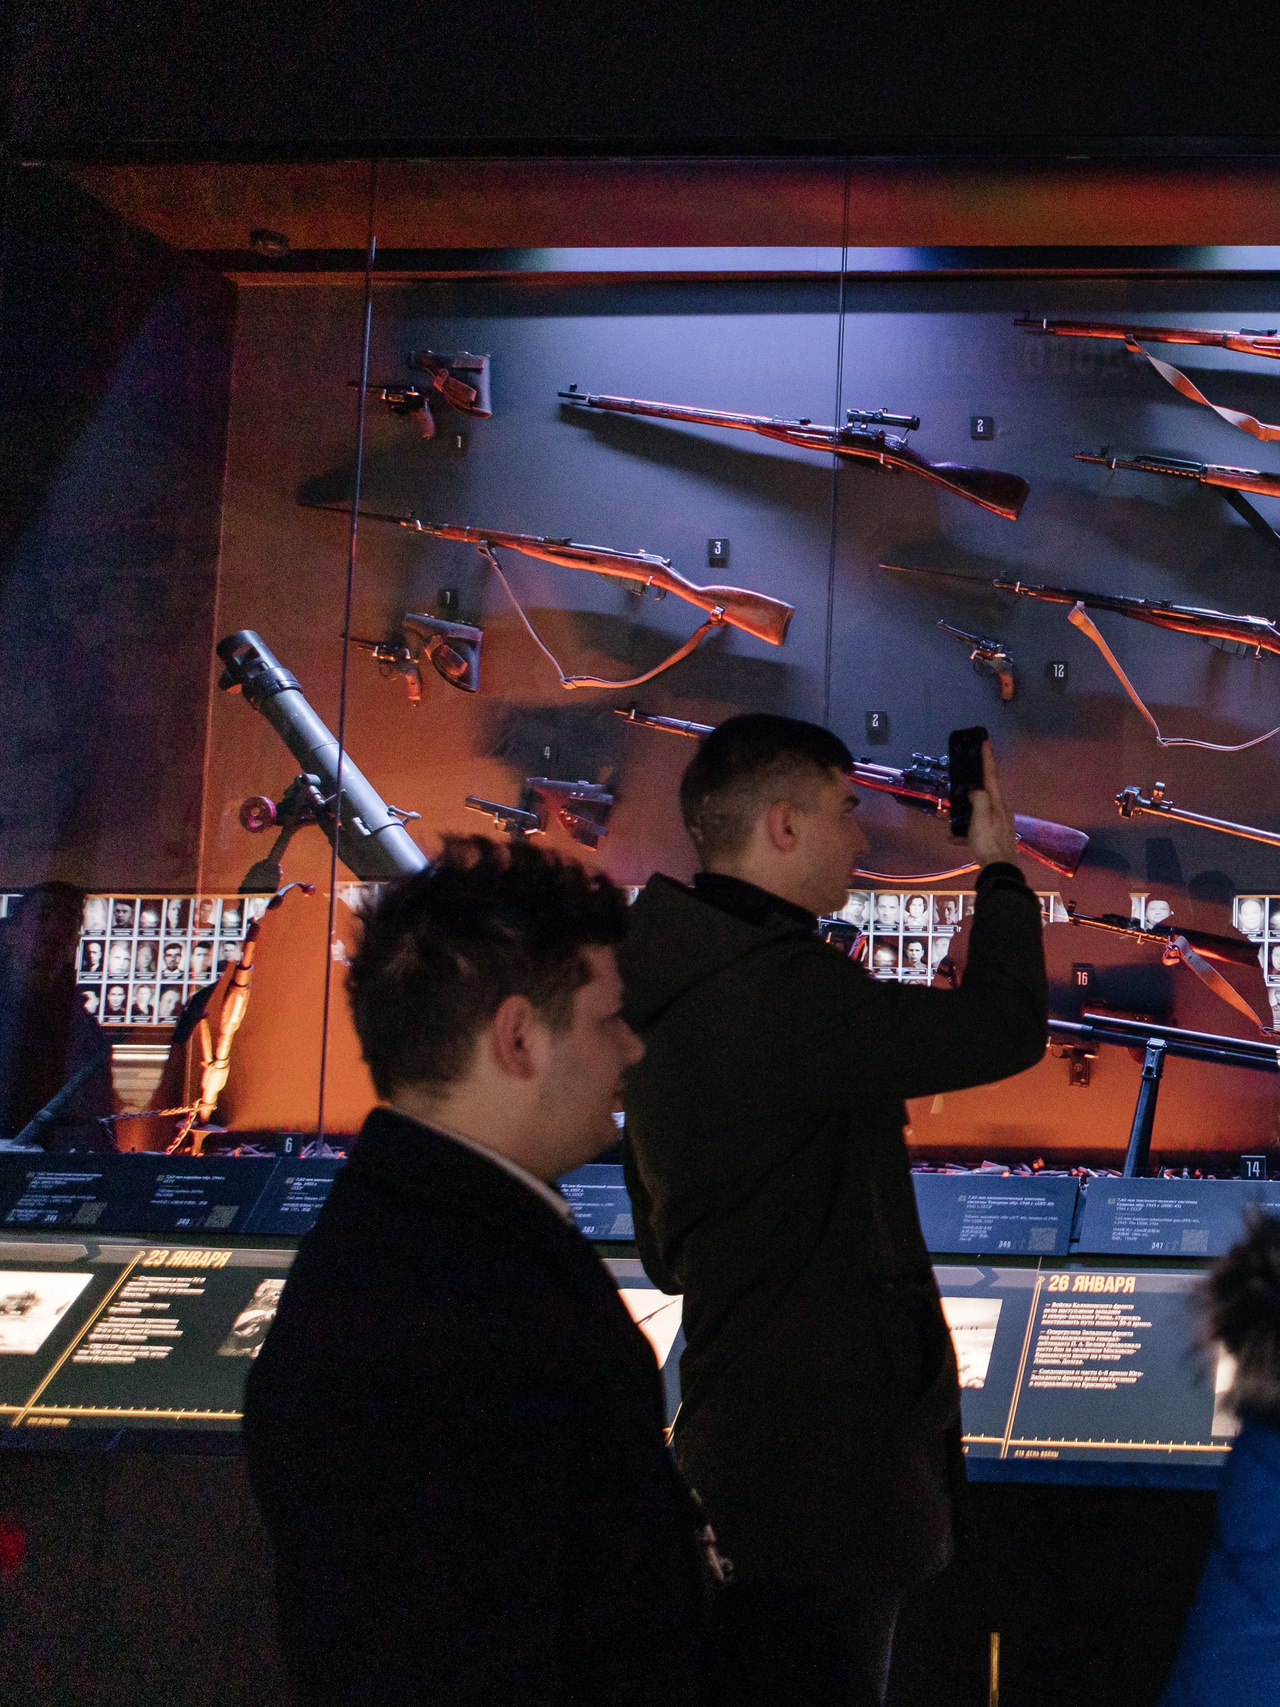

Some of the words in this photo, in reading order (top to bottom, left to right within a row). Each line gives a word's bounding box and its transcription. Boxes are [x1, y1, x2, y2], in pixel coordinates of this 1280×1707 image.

[977, 419, 984, 433] 2
[456, 435, 462, 449] 1
[714, 541, 722, 555] 3
[445, 591, 451, 604] 1
[1053, 664, 1064, 678] 12
[872, 713, 879, 727] 2
[543, 746, 551, 760] 4
[1076, 971, 1088, 986] 16
[285, 1138, 293, 1152] 6
[1246, 1161, 1260, 1177] 14
[142, 1249, 170, 1267] 23
[165, 1250, 233, 1268] ЯНВАРЯ
[1047, 1274, 1070, 1292] 26
[1072, 1275, 1136, 1293] ЯНВАРЯ
